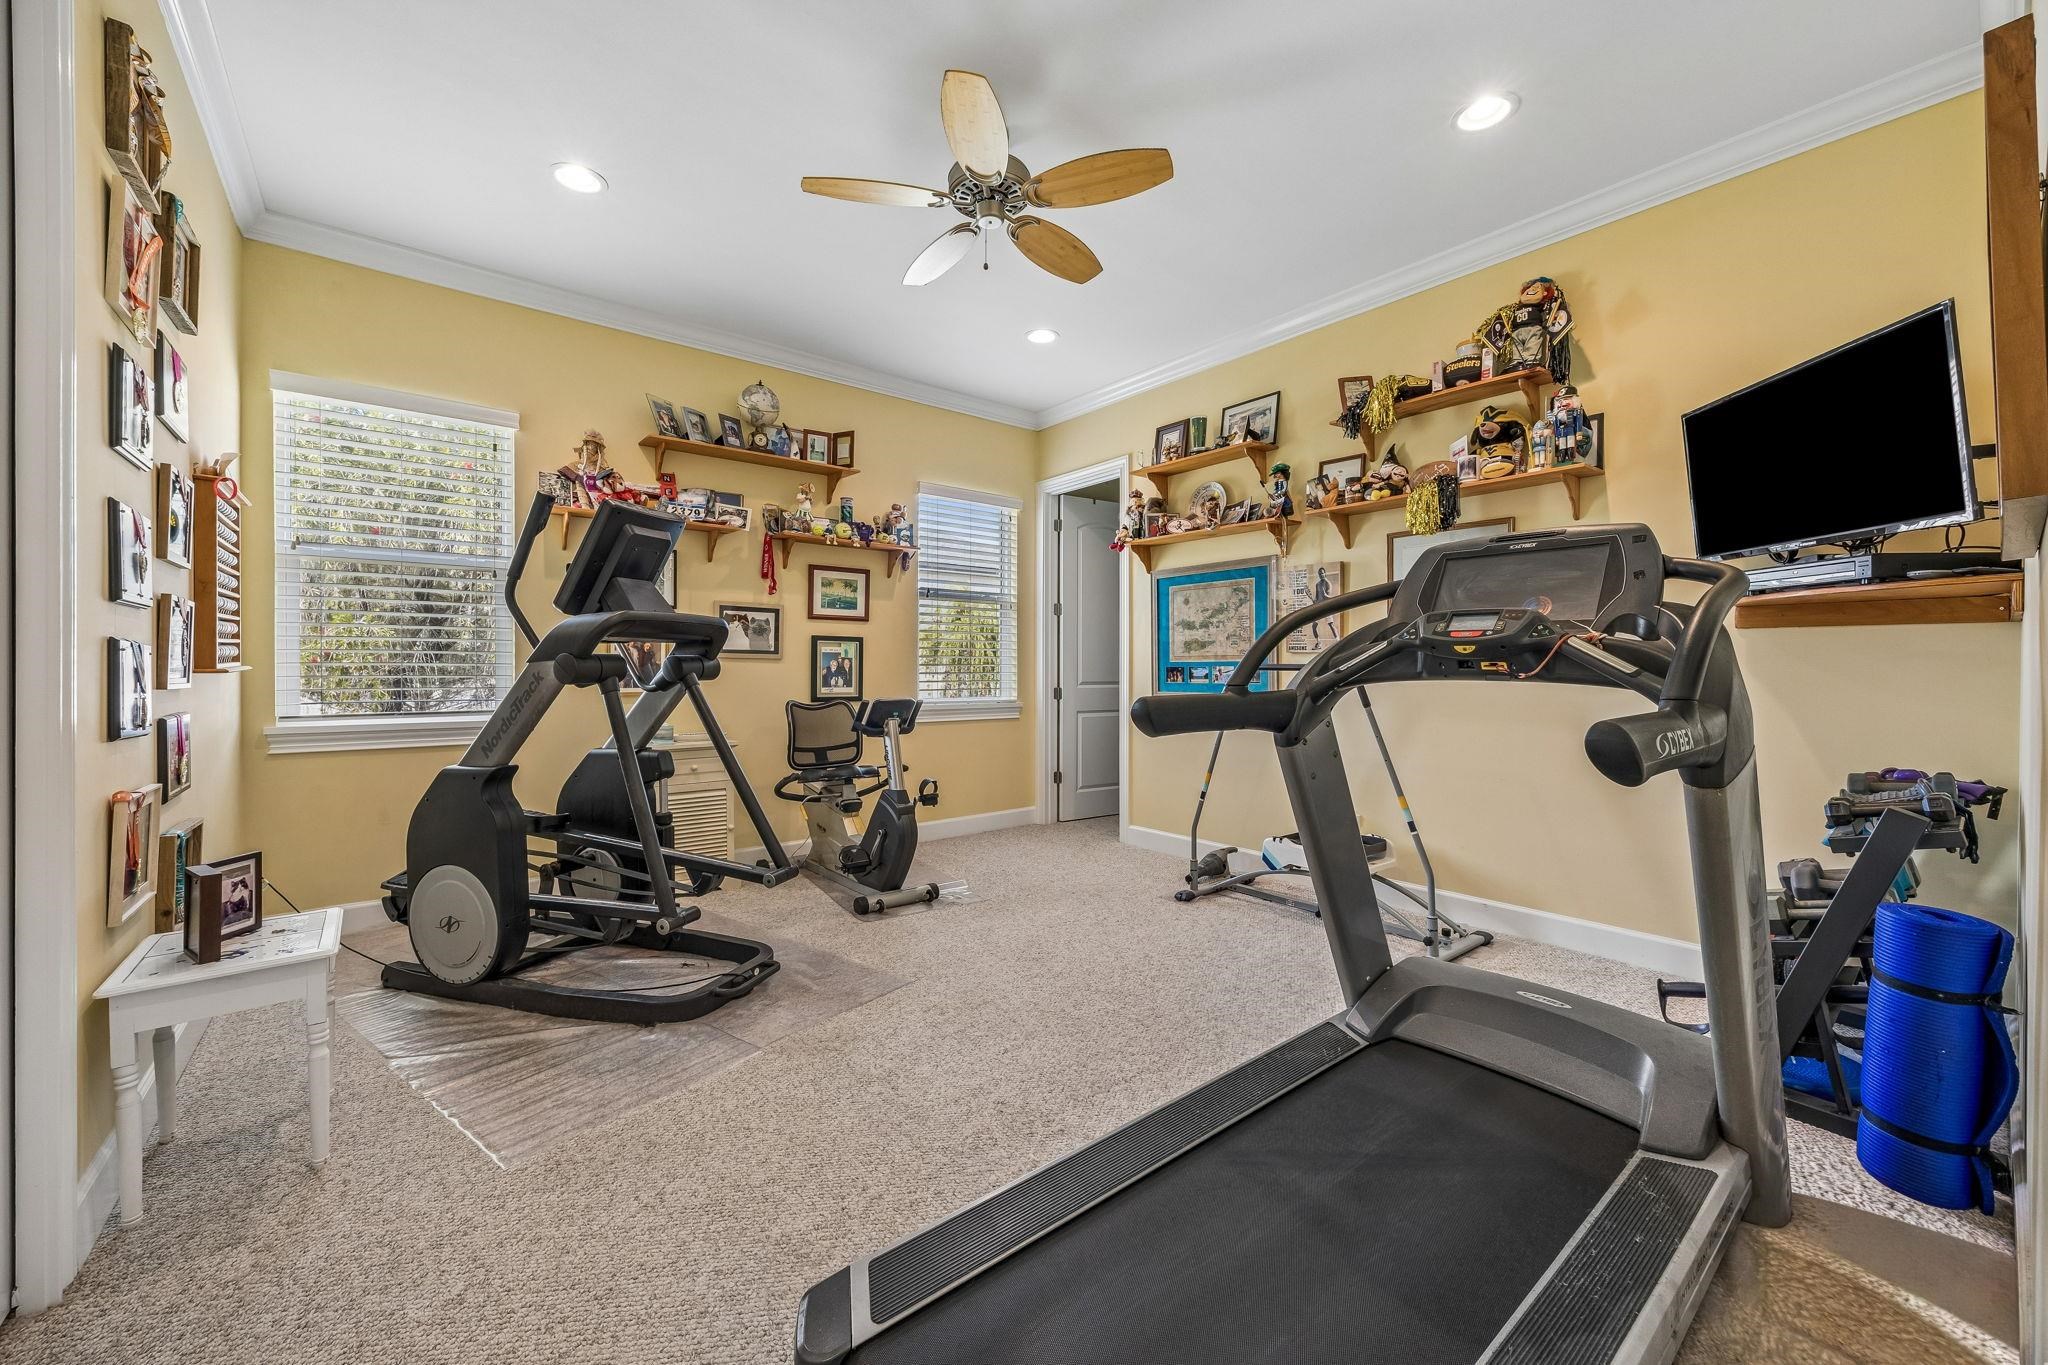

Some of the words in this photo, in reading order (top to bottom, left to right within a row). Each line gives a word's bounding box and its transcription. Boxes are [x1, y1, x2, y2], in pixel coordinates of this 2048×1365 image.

[1446, 359, 1481, 373] Steelers
[671, 506, 701, 517] 2379
[481, 671, 544, 759] NordicTrack
[1666, 727, 1695, 755] CYBEX
